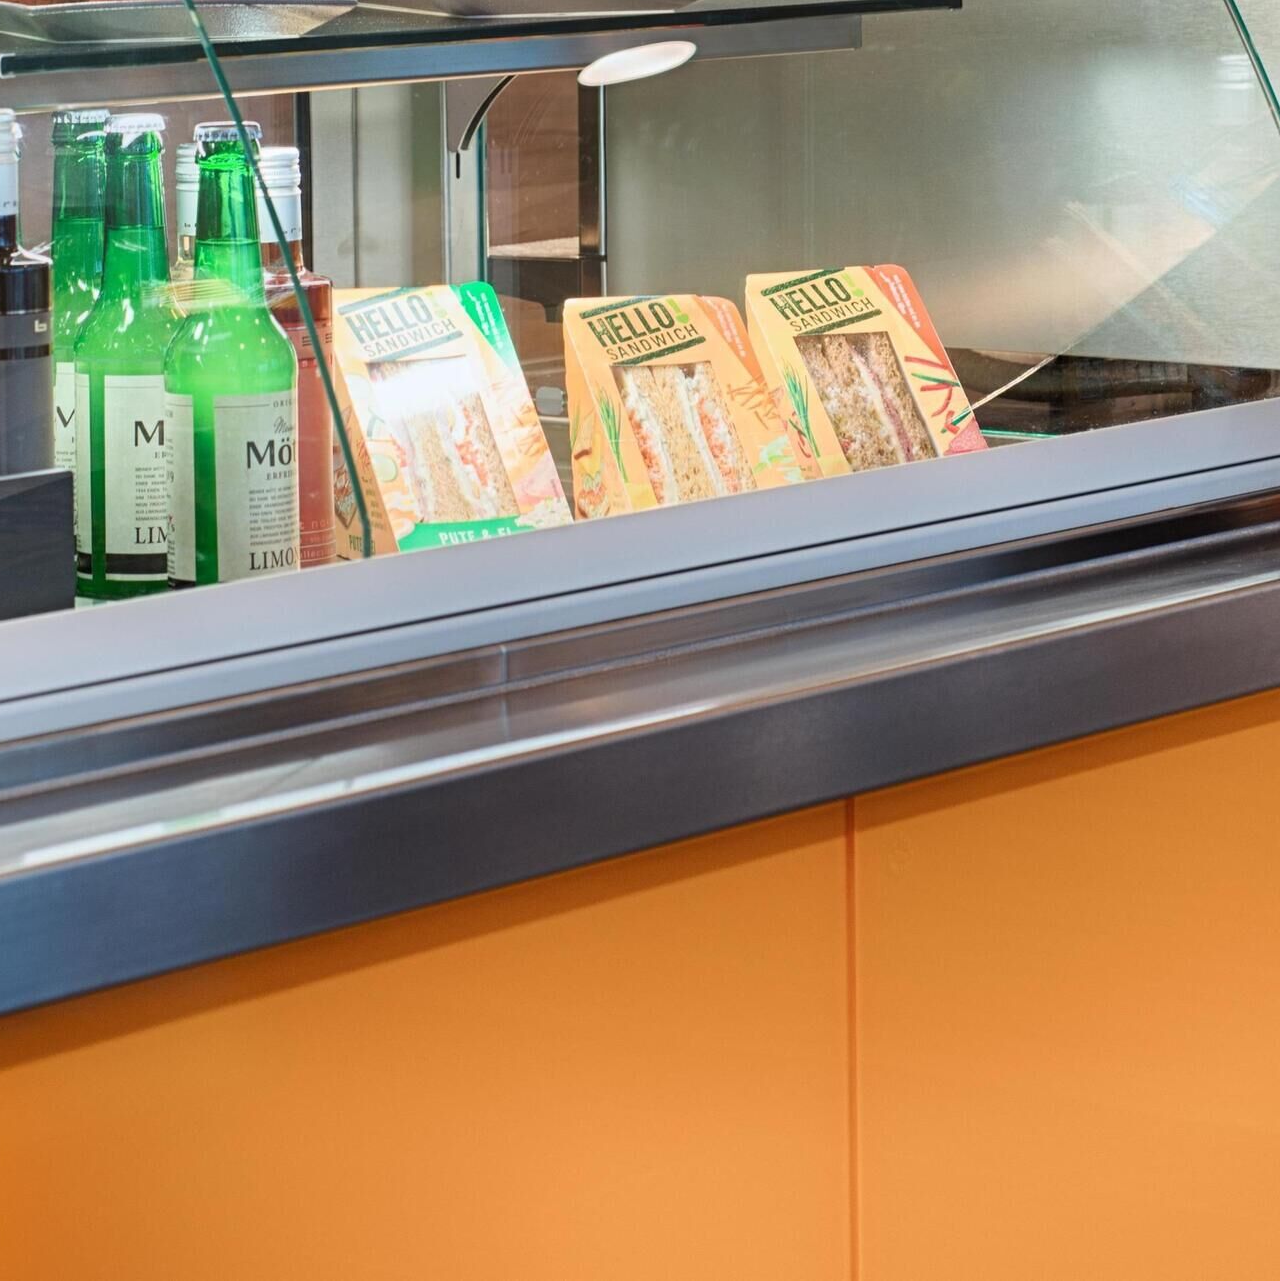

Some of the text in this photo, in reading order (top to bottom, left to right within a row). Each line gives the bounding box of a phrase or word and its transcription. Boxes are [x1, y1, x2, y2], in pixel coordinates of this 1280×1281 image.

[789, 296, 874, 333] SANDWICH
[362, 318, 457, 357] SANDWICH
[605, 323, 699, 362] SANDWICH
